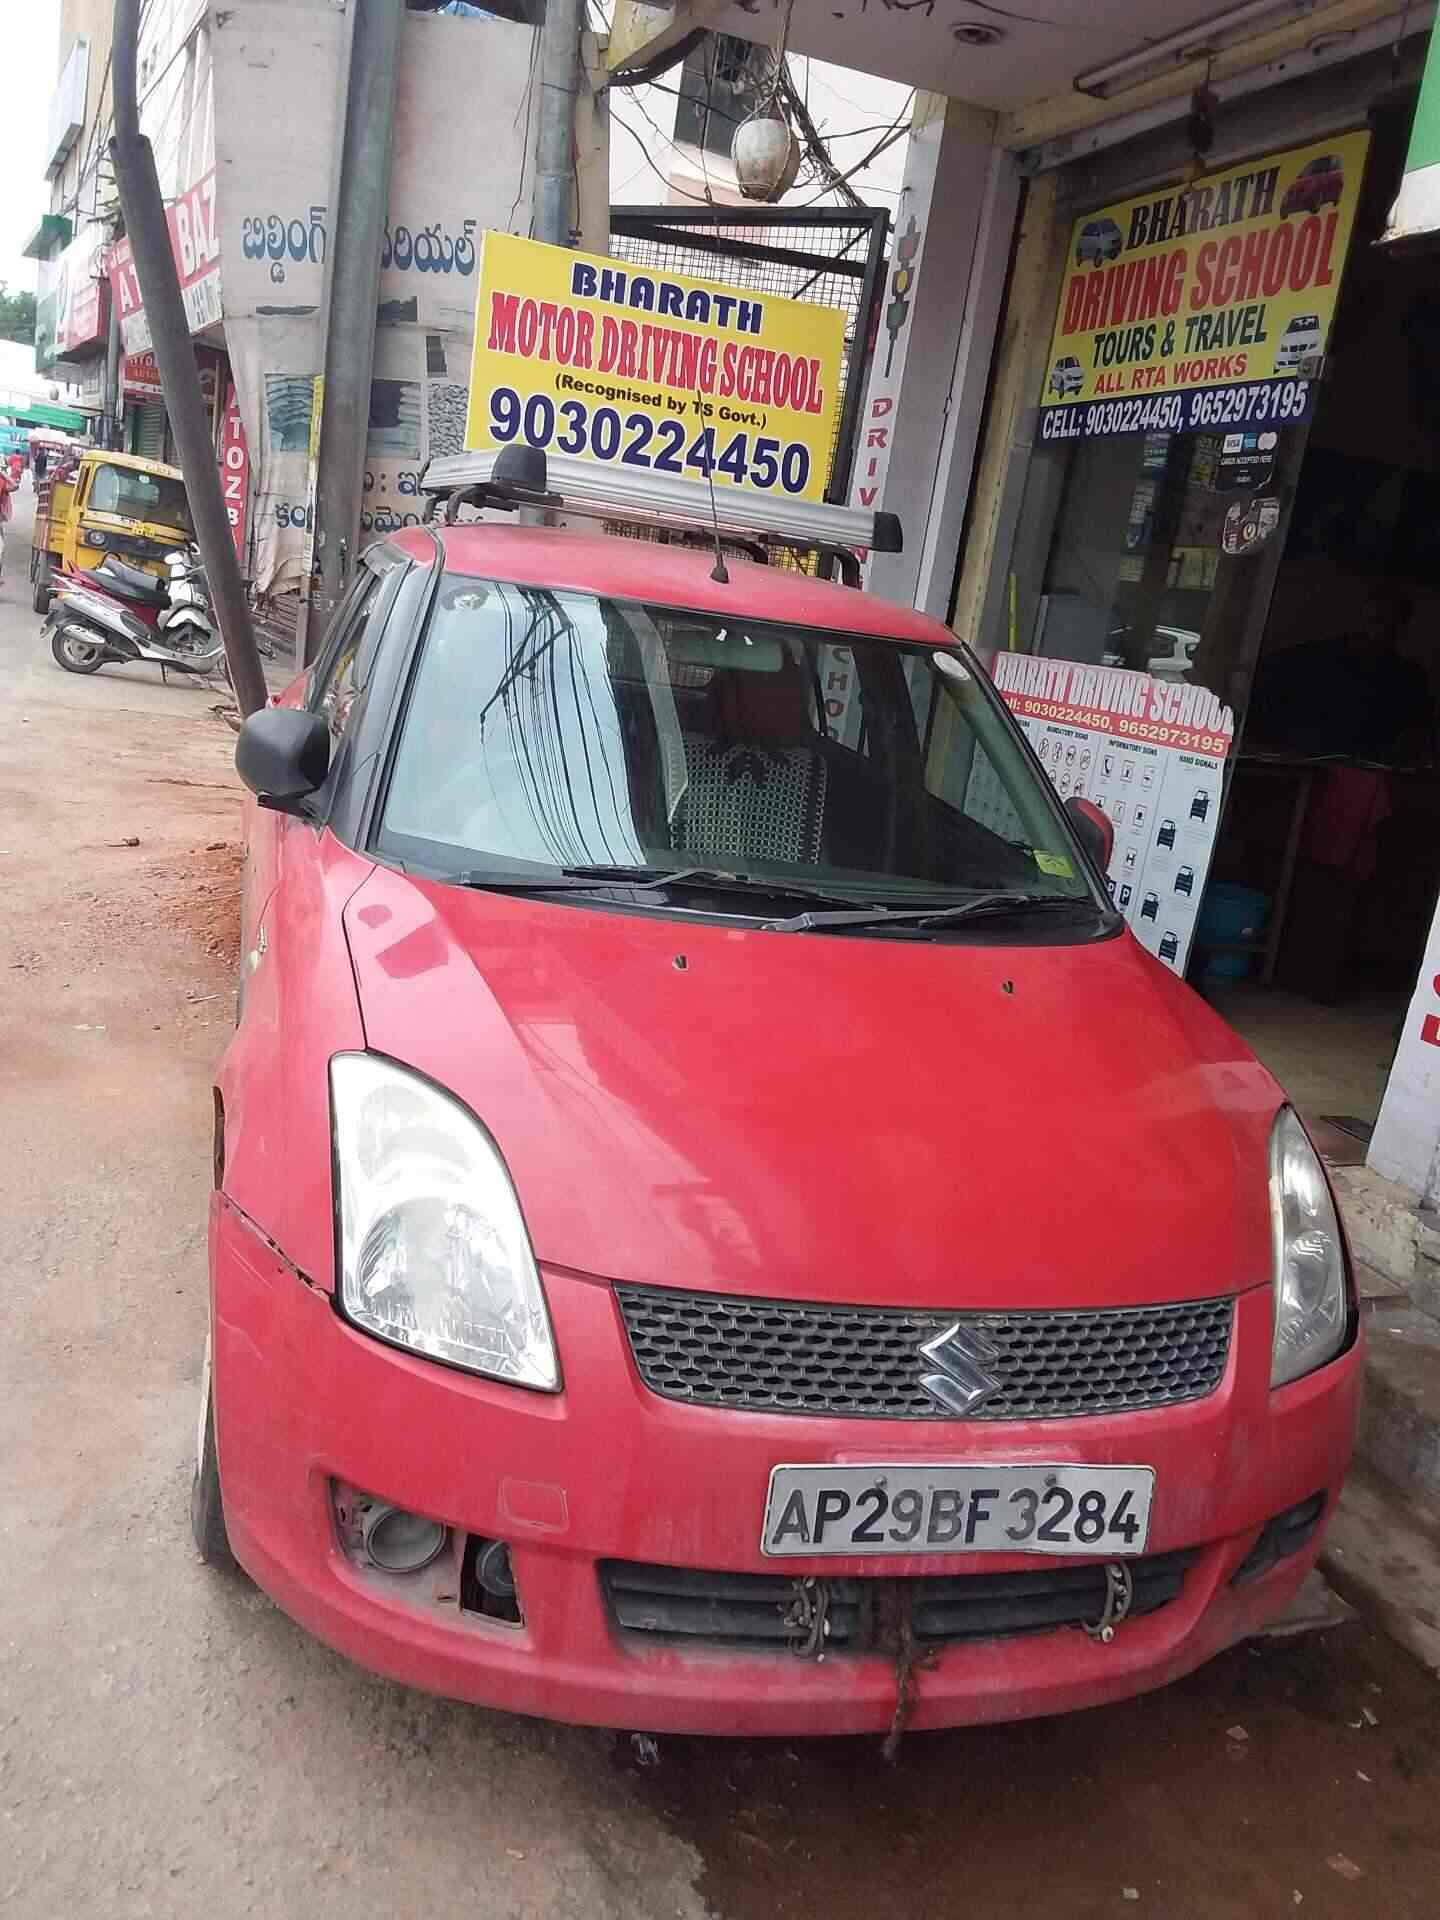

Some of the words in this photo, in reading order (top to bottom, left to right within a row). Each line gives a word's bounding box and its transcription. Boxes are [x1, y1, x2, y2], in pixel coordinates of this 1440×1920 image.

[176, 175, 219, 278] BAZ
[1125, 167, 1280, 250] BHARATH
[571, 262, 764, 334] BHARATH
[1061, 248, 1187, 336] DRIVING
[1191, 213, 1339, 311] SCHOOL
[487, 292, 593, 367] MOTOR
[598, 310, 718, 393] DRIVING
[718, 339, 824, 414] SCHOOL
[1093, 325, 1155, 368] TOURS
[1160, 320, 1176, 357] &
[1183, 303, 1268, 354] TRAVEL
[555, 372, 662, 410] (Recognised
[666, 394, 687, 415] by
[692, 399, 714, 417] TS
[718, 405, 767, 429] Govt.)
[1094, 368, 1127, 394] ALL
[1131, 361, 1166, 389] RTA
[1173, 353, 1248, 384] WORKS
[489, 387, 810, 493] 9030224450
[1042, 405, 1084, 440] CELL:
[1085, 396, 1186, 435] 9030224450,
[1190, 382, 1309, 427] 9652973195
[994, 653, 1071, 703] BHARATH
[1069, 664, 1150, 717] DRIVING
[1004, 698, 1020, 711] ell:
[1024, 699, 1113, 732] 9030224450,
[1119, 719, 1226, 753] 9652973195
[1179, 755, 1194, 765] HAND
[1194, 759, 1219, 770] SIGNALS
